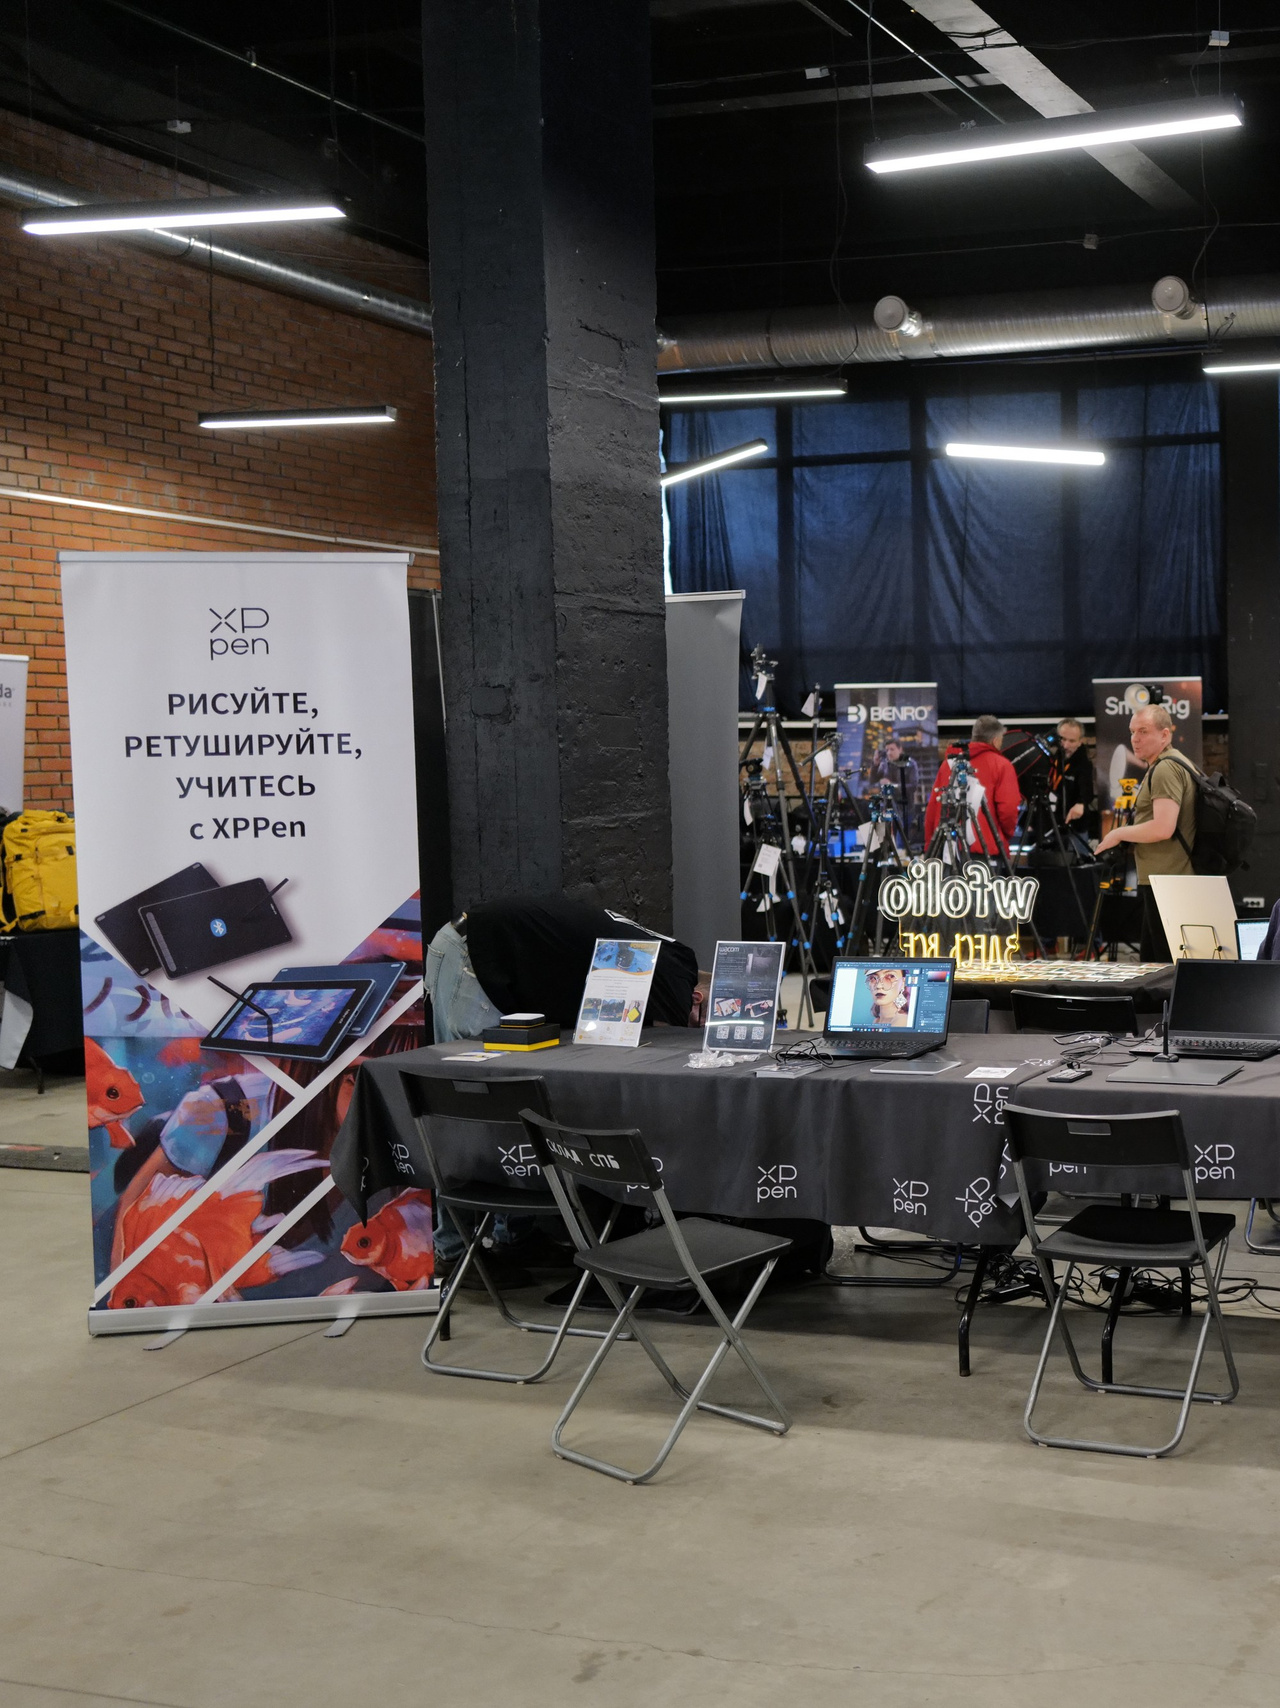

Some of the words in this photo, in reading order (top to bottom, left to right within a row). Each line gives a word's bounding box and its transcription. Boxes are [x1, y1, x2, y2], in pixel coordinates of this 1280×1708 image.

[209, 608, 269, 633] XP
[210, 638, 269, 660] pen
[167, 687, 318, 719] РИСУЙТЕ,
[870, 705, 928, 722] BENRO
[1105, 695, 1190, 719] SmRig
[125, 728, 362, 760] РЕТУШИРУЙТЕ,
[176, 775, 316, 799] УЧИТЕСЬ
[212, 817, 306, 839] XPPen
[546, 1138, 583, 1166] СКЛАД
[590, 1153, 620, 1169] СПБ
[1194, 1144, 1235, 1164] XP
[757, 1165, 797, 1184] XP
[1194, 1165, 1235, 1184] pen
[757, 1185, 797, 1203] pen
[893, 1177, 929, 1199] XP
[893, 1198, 926, 1216] pen
